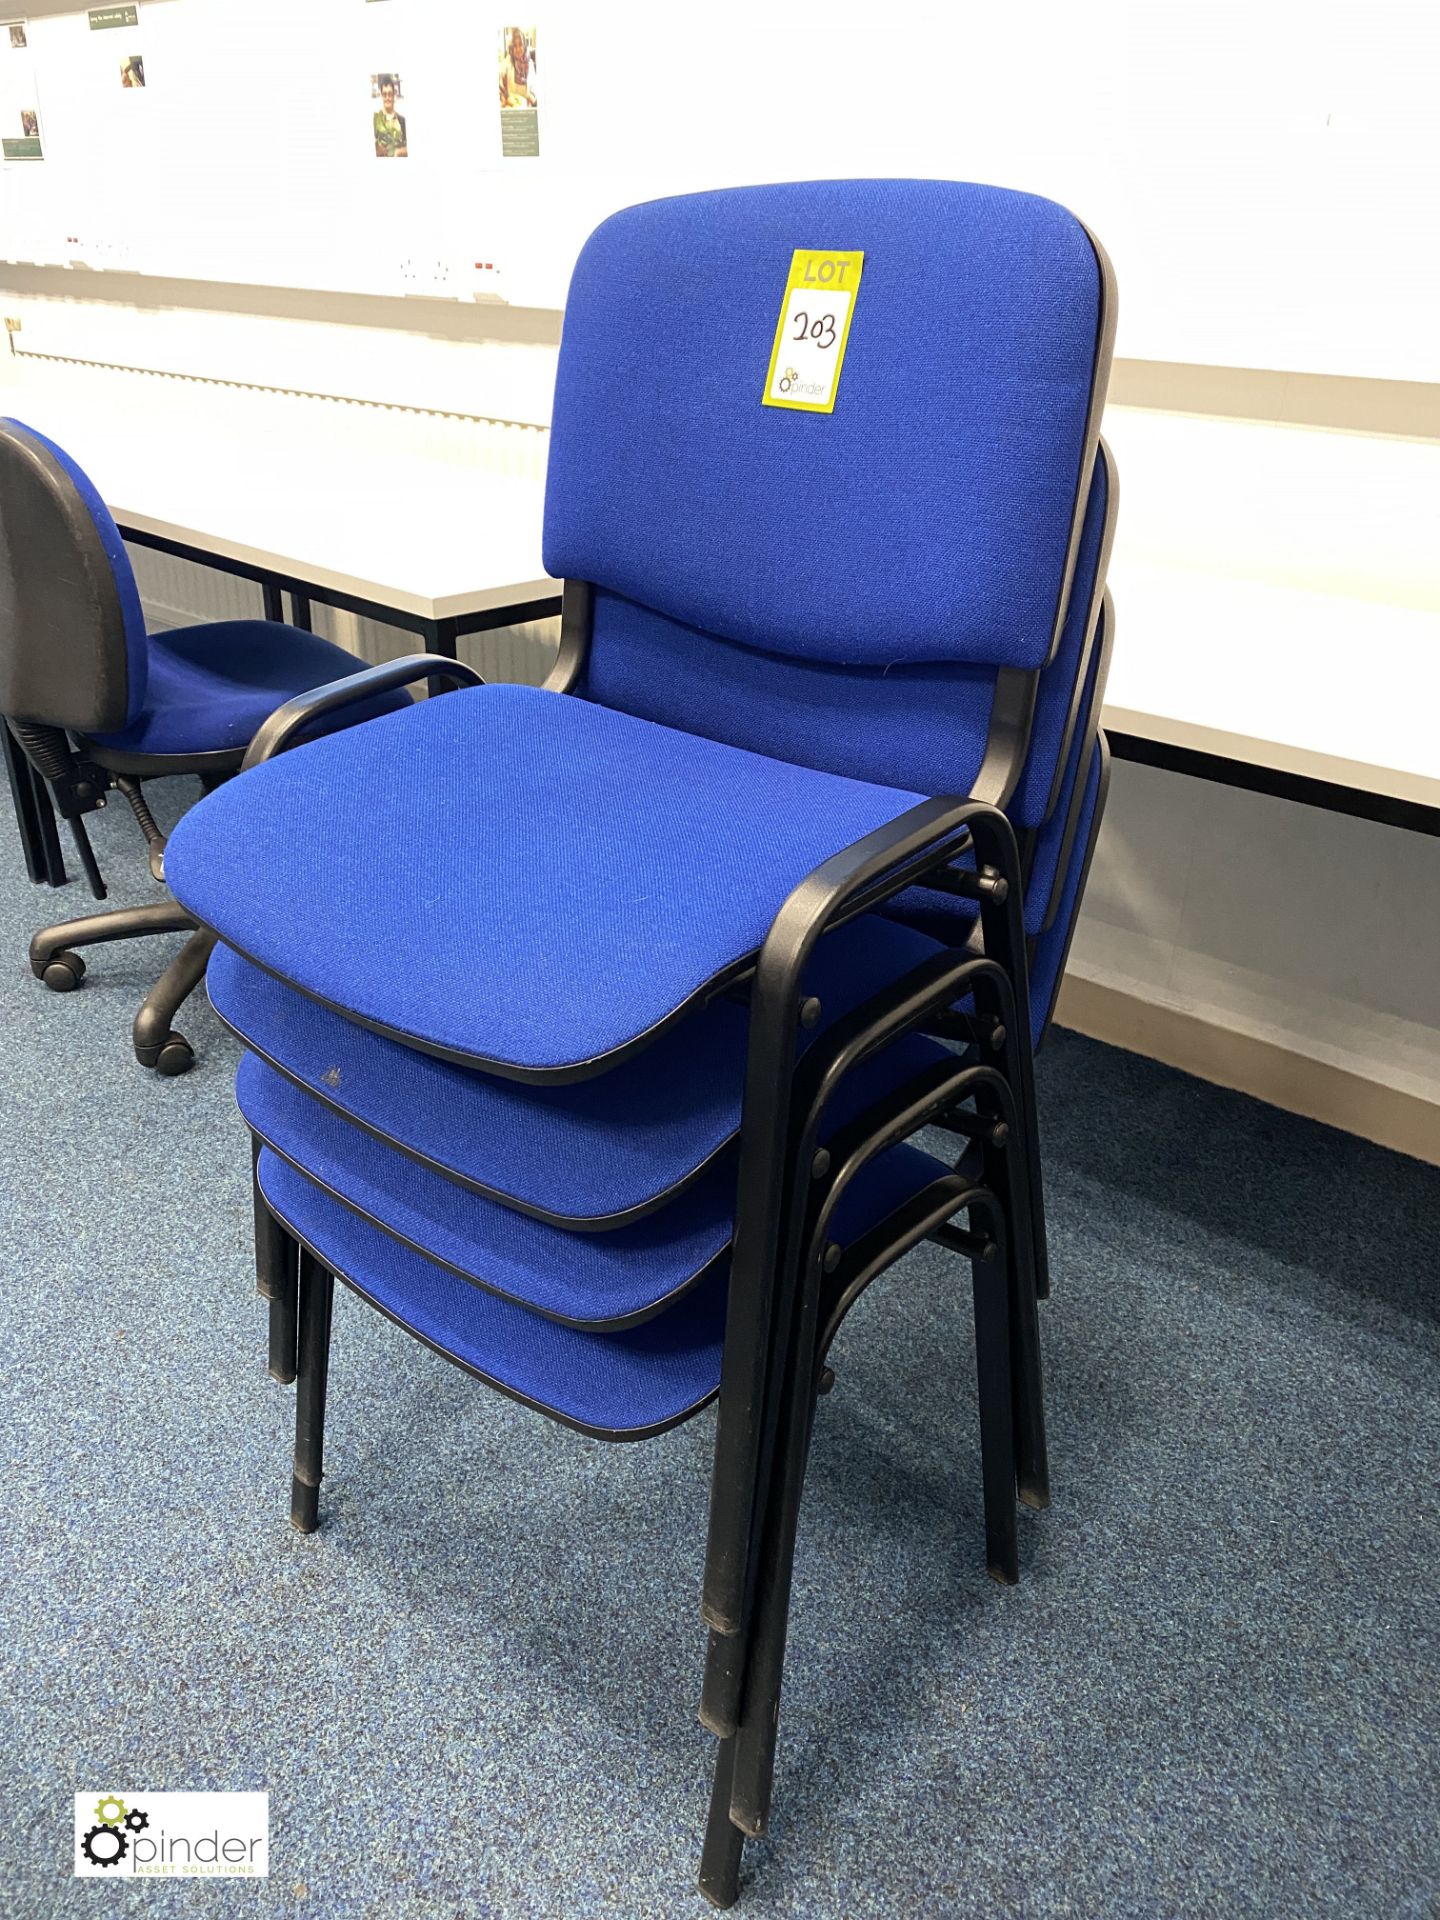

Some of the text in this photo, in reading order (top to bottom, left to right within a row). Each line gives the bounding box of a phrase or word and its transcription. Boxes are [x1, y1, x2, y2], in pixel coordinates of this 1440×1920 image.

[803, 259, 850, 284] LOT
[793, 311, 837, 349] 203
[790, 382, 826, 396] pinder
